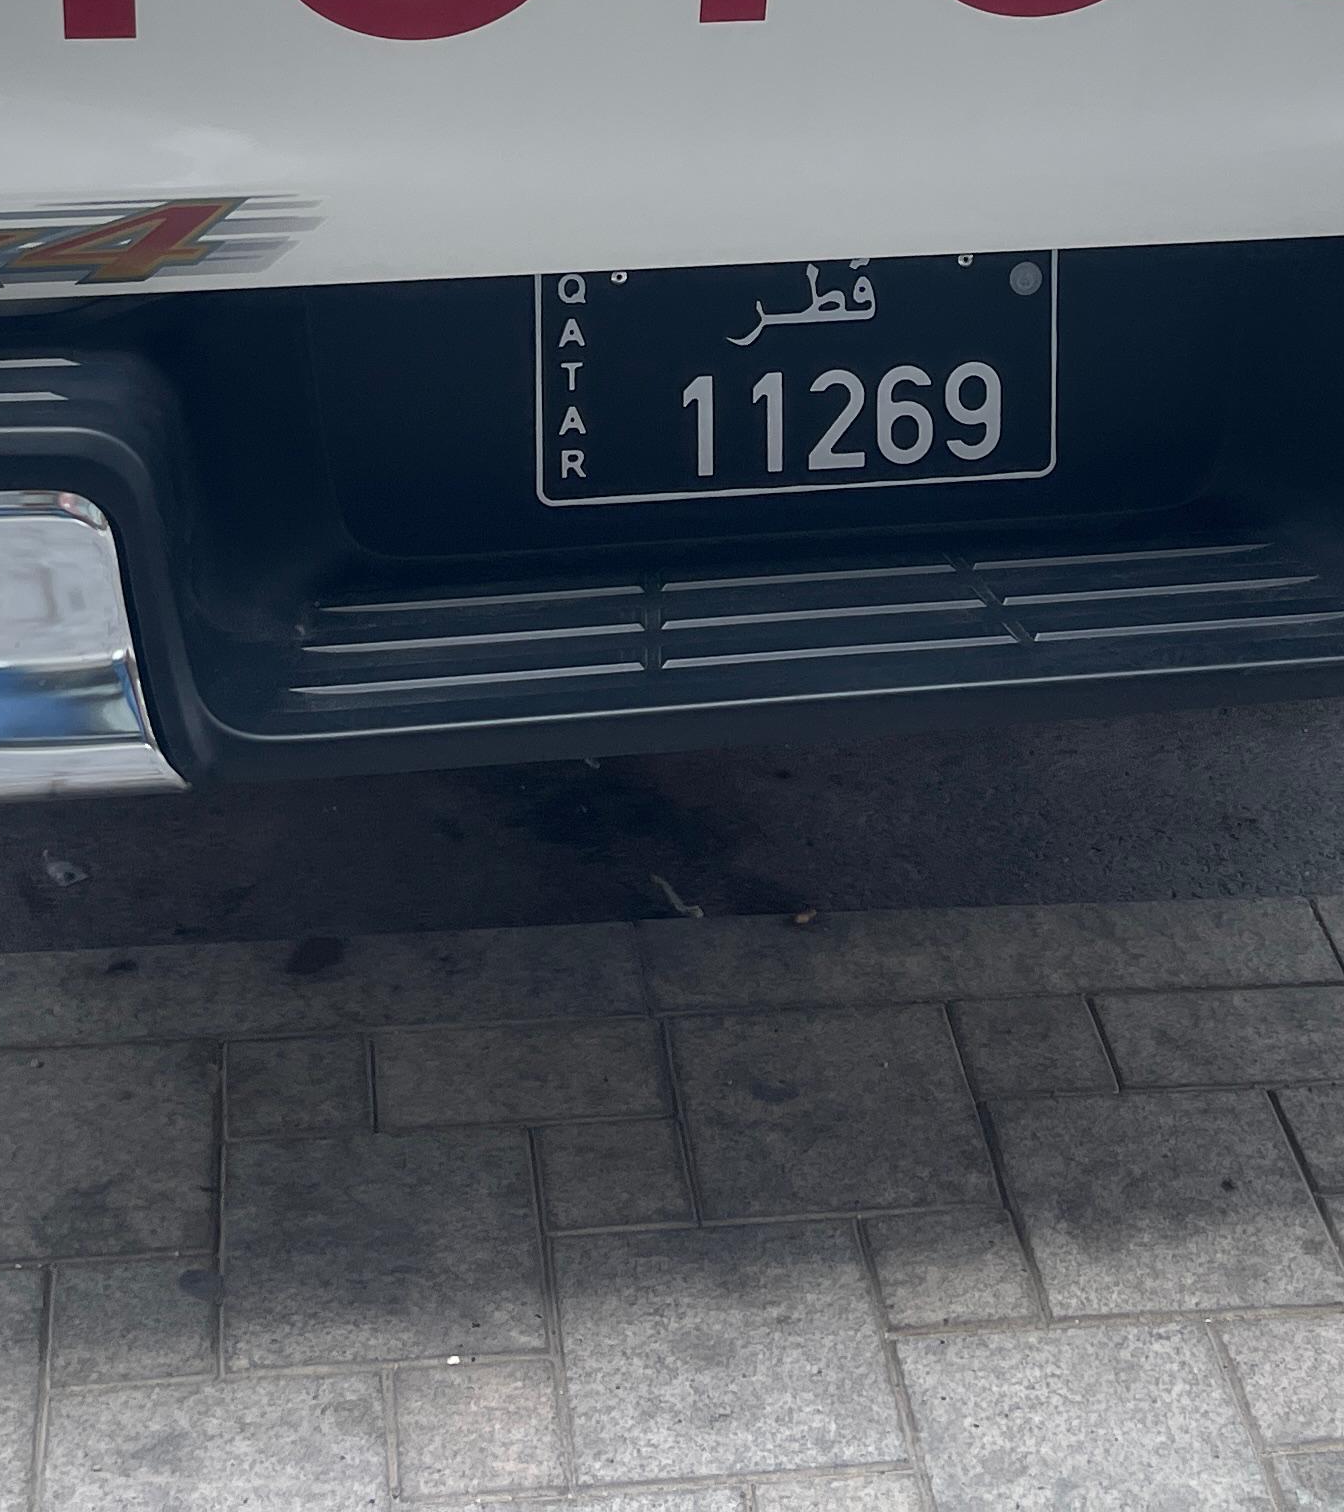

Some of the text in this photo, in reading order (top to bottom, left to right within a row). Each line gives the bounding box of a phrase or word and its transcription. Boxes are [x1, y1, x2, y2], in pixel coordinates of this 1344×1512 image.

[726, 258, 877, 346] قطر
[557, 273, 587, 480] QATAR
[682, 361, 1002, 477] 11269
